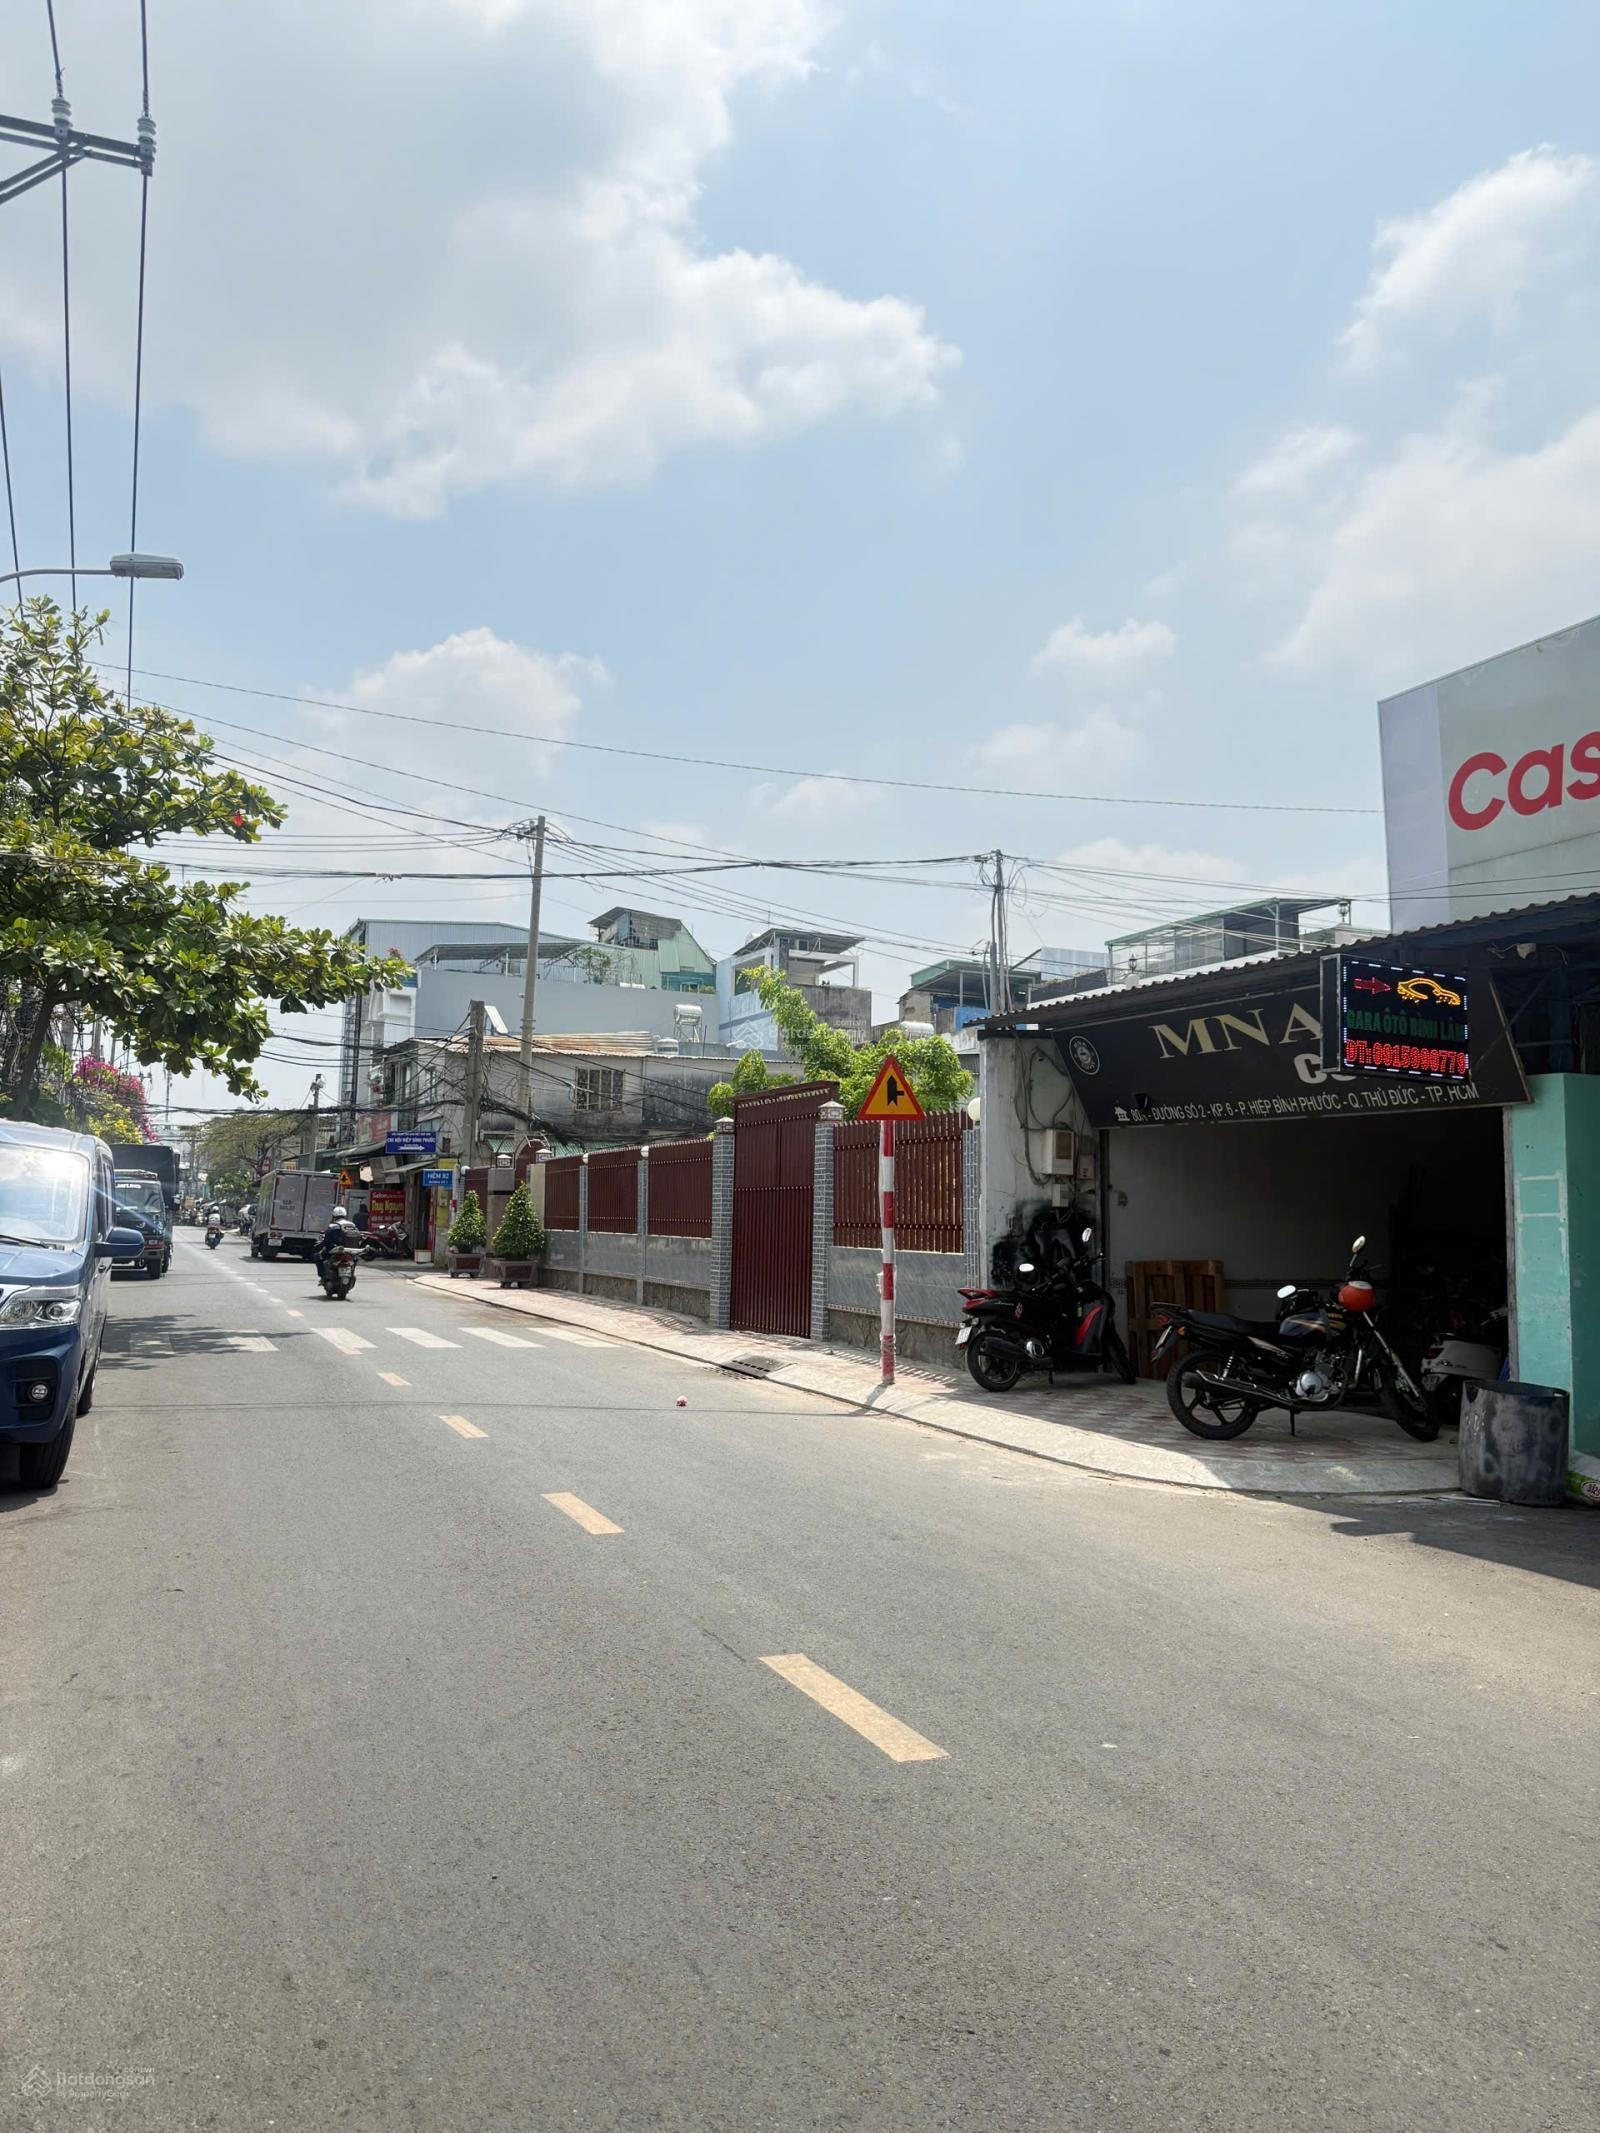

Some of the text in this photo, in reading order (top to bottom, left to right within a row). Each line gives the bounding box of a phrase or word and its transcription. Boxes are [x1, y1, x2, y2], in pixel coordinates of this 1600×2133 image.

[1346, 1008, 1381, 1032] GARA
[1151, 1104, 1185, 1121] ĐƯỜNG
[1185, 1102, 1199, 1119] SỐ
[1199, 1104, 1207, 1117] 2
[1249, 1099, 1272, 1117] HIỆP
[1272, 1095, 1299, 1113] BÌNH
[1299, 1091, 1341, 1112] PHƯỚC
[1361, 1086, 1388, 1107] THỦ
[1389, 1085, 1419, 1105] ĐỨC
[1448, 1082, 1479, 1103] HCM
